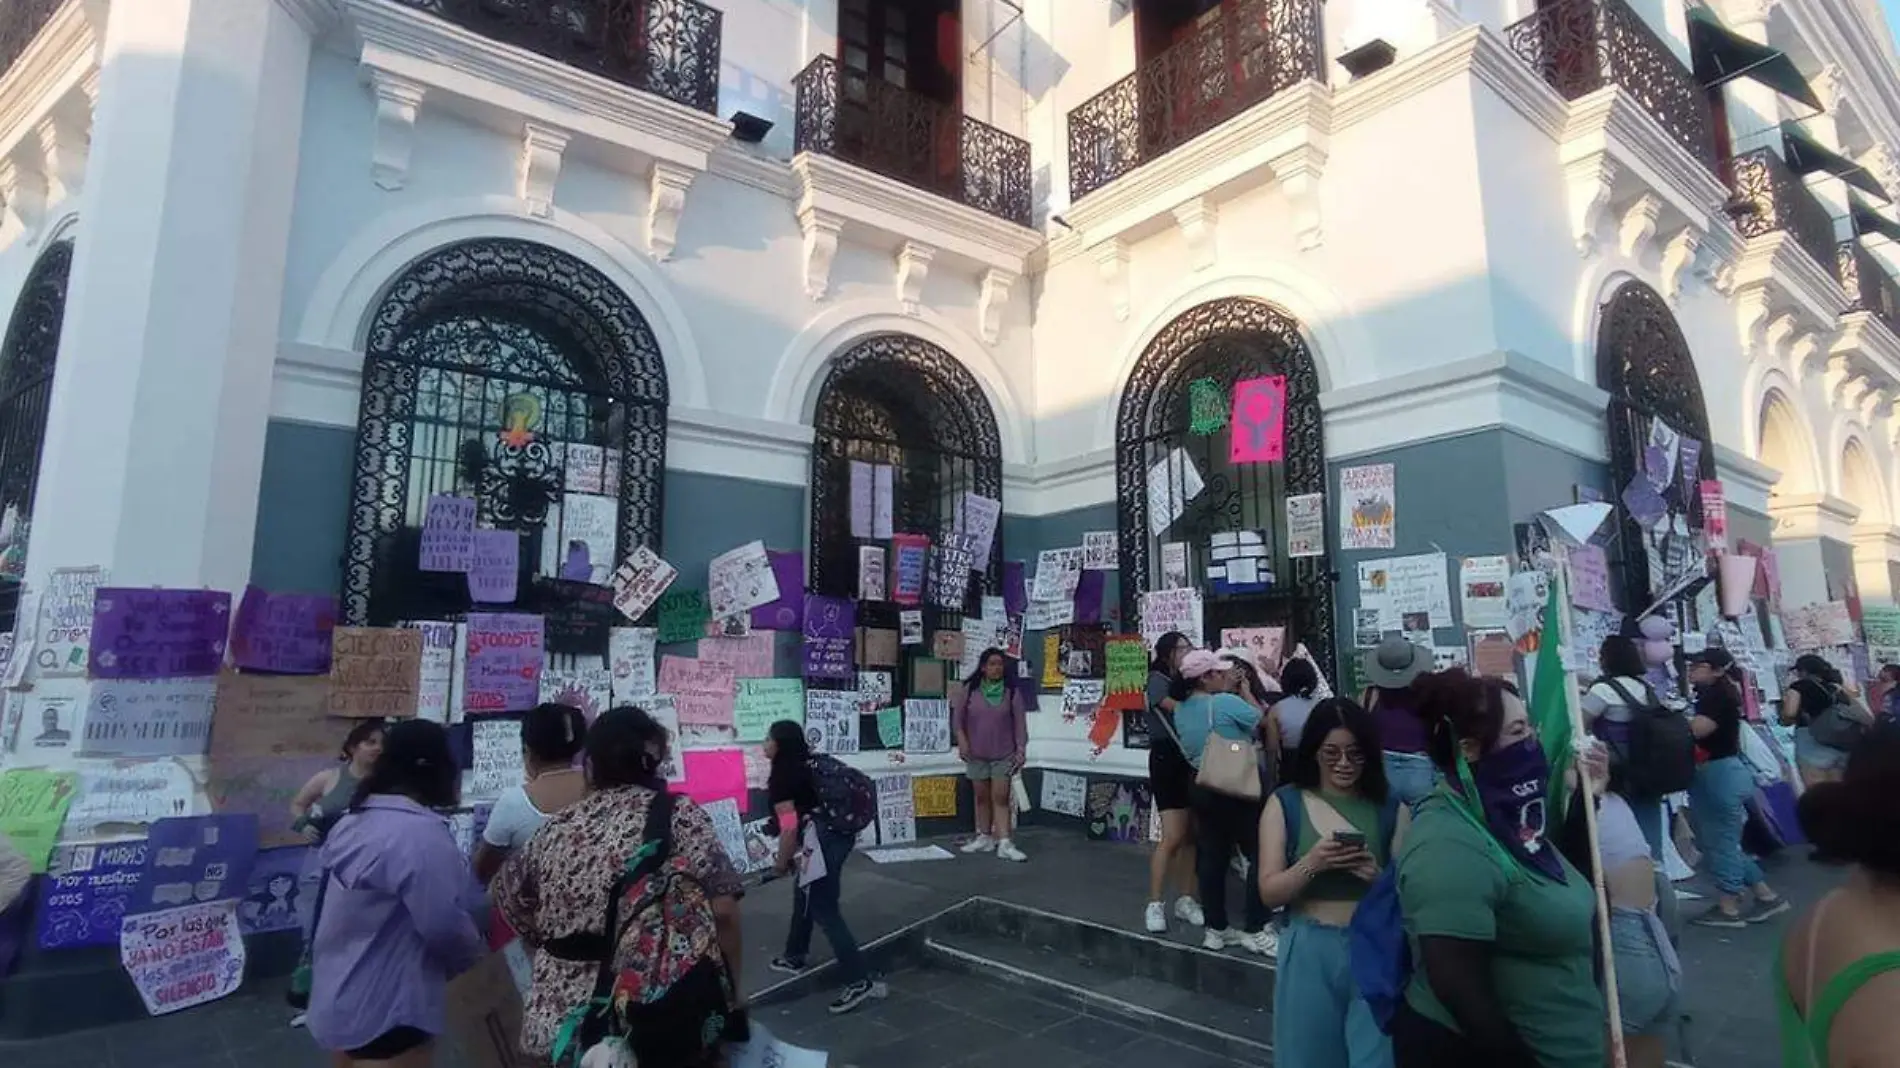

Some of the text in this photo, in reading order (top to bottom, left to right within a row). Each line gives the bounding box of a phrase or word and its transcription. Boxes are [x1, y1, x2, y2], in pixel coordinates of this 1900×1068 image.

[141, 921, 179, 941] Por
[182, 916, 203, 933] las
[128, 949, 150, 969] YA
[153, 944, 177, 962] NO
[155, 974, 218, 1007] SILENCIO
